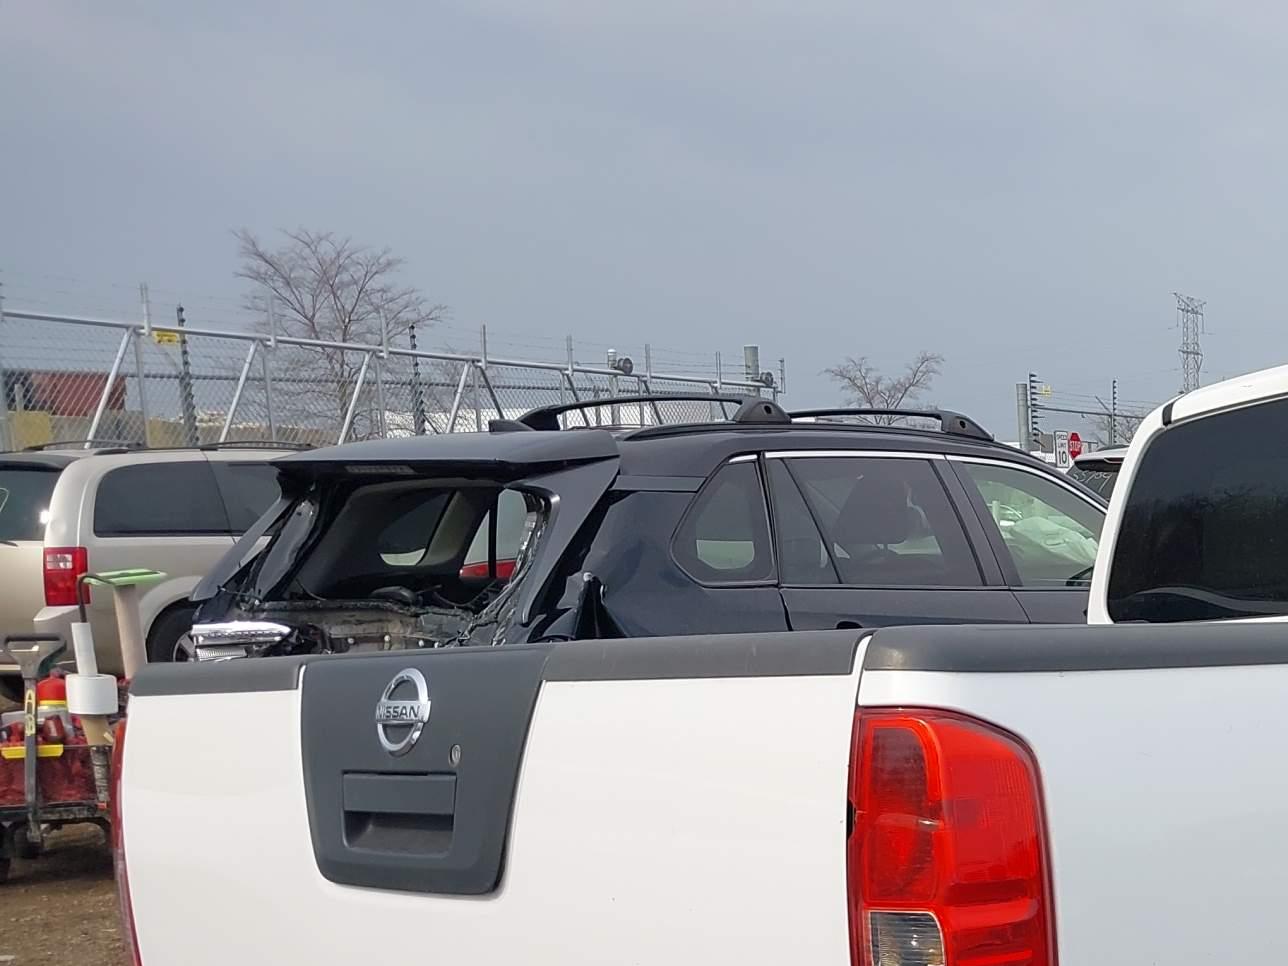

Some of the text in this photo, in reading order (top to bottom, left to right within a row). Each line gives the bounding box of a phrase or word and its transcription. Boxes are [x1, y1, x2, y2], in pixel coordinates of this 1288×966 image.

[1070, 440, 1081, 451] STOP
[1058, 450, 1067, 464] 10
[376, 703, 421, 719] NISSAN
